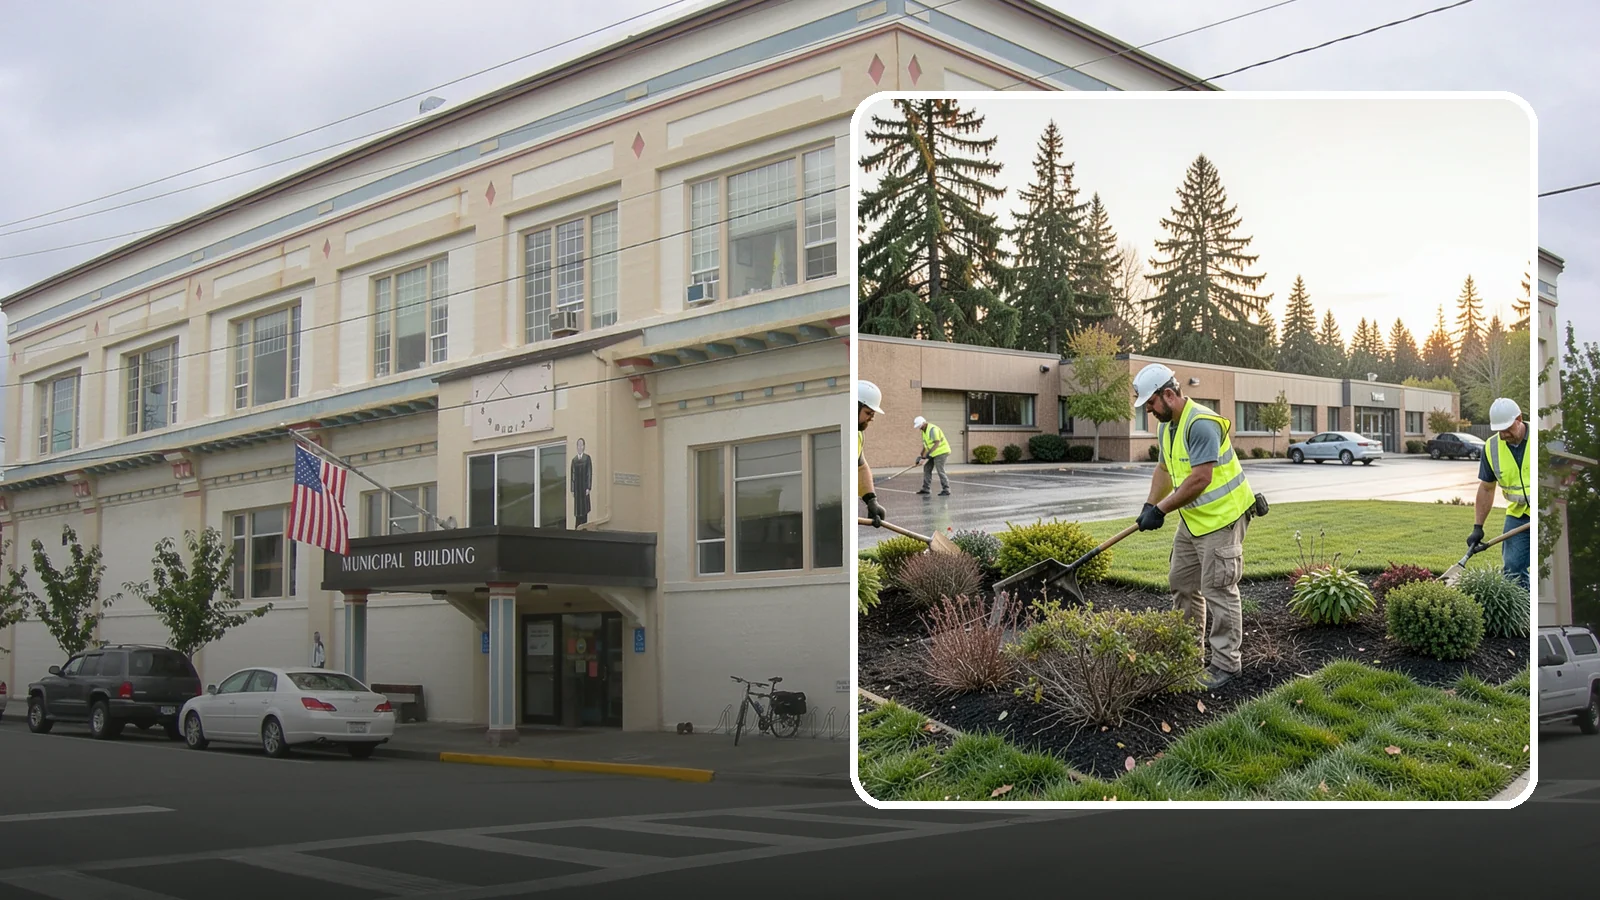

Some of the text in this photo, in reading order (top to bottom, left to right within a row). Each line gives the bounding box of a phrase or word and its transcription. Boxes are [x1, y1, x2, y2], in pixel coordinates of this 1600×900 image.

[546, 361, 552, 371] 6
[475, 390, 479, 398] 7
[536, 402, 540, 410] 4
[480, 406, 485, 415] 8
[487, 417, 493, 426] 9
[528, 414, 533, 422] 3
[494, 423, 500, 432] 10
[521, 420, 526, 428] 2
[507, 425, 513, 433] 12
[342, 546, 475, 572] MUNICIPAL BUILDING
